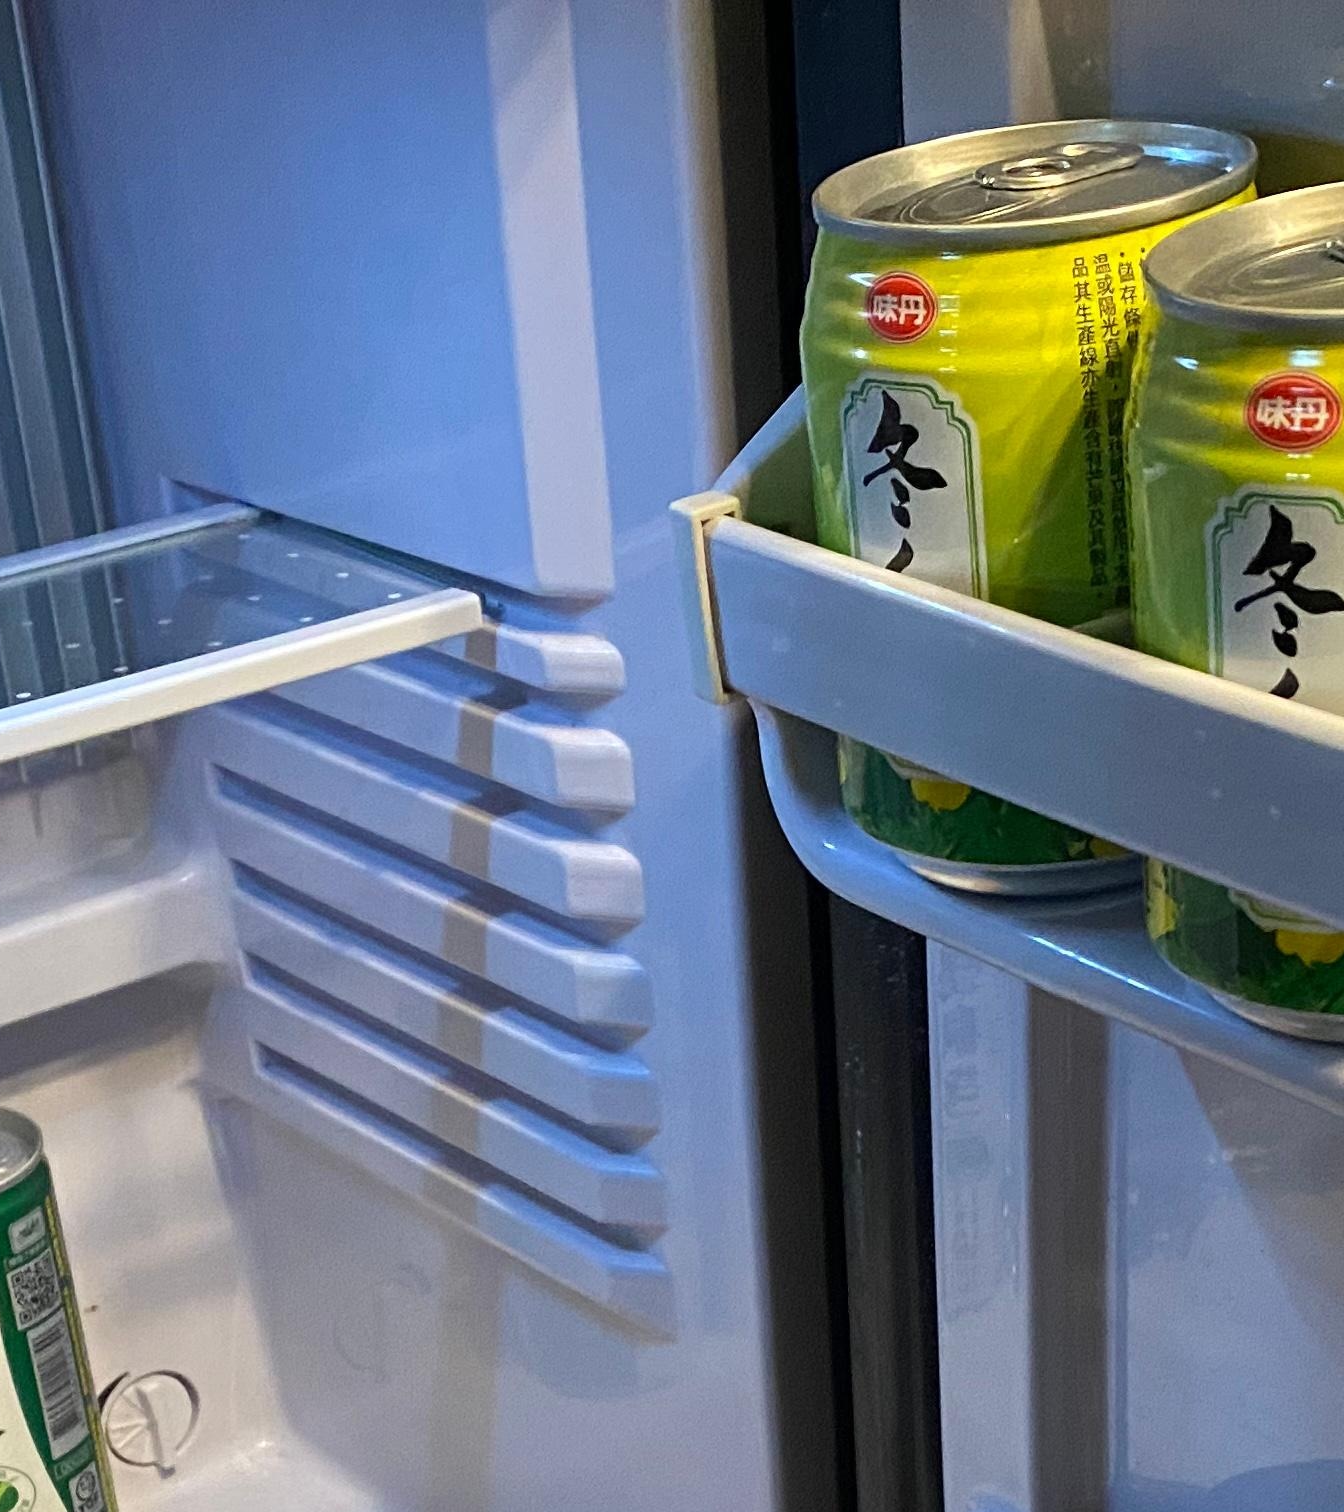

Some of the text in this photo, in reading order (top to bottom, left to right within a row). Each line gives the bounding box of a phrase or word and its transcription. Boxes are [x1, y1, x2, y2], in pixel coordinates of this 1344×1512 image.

[872, 293, 927, 326] 味丹
[1256, 396, 1329, 432] 味丹
[863, 390, 948, 573] 冬
